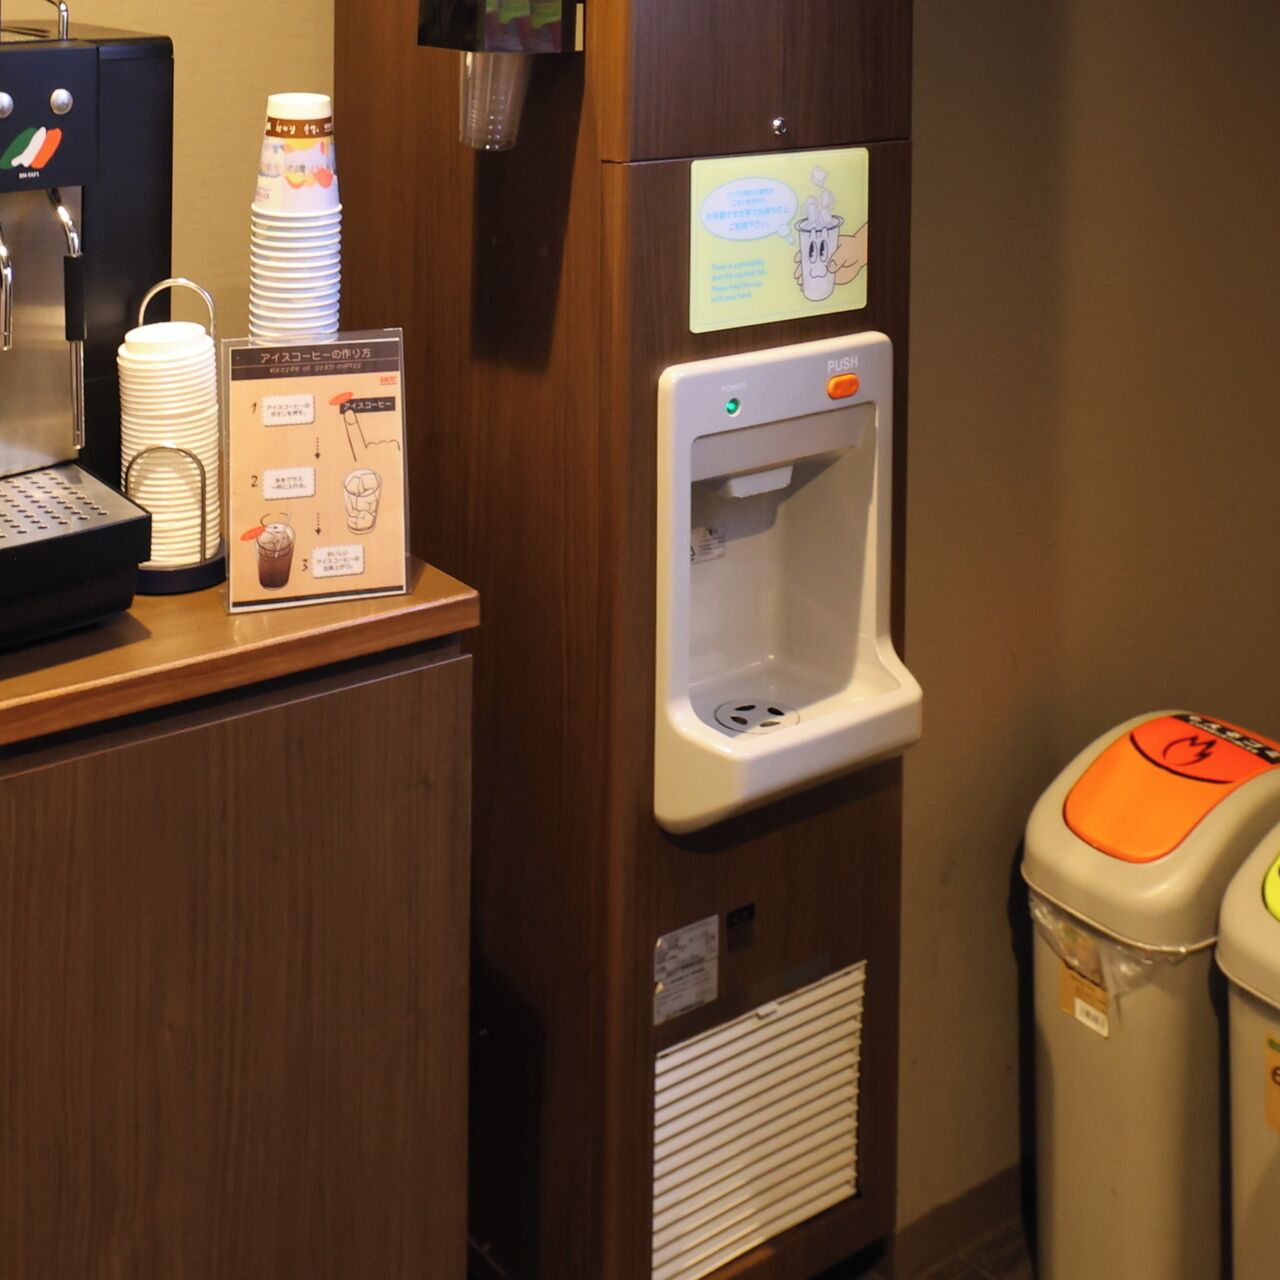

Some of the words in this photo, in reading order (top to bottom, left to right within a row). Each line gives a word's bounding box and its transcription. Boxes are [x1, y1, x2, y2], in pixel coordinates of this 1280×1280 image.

[260, 348, 371, 364] アイスコーヒーの作り方
[827, 355, 858, 372] PUSH
[251, 475, 258, 487] 2
